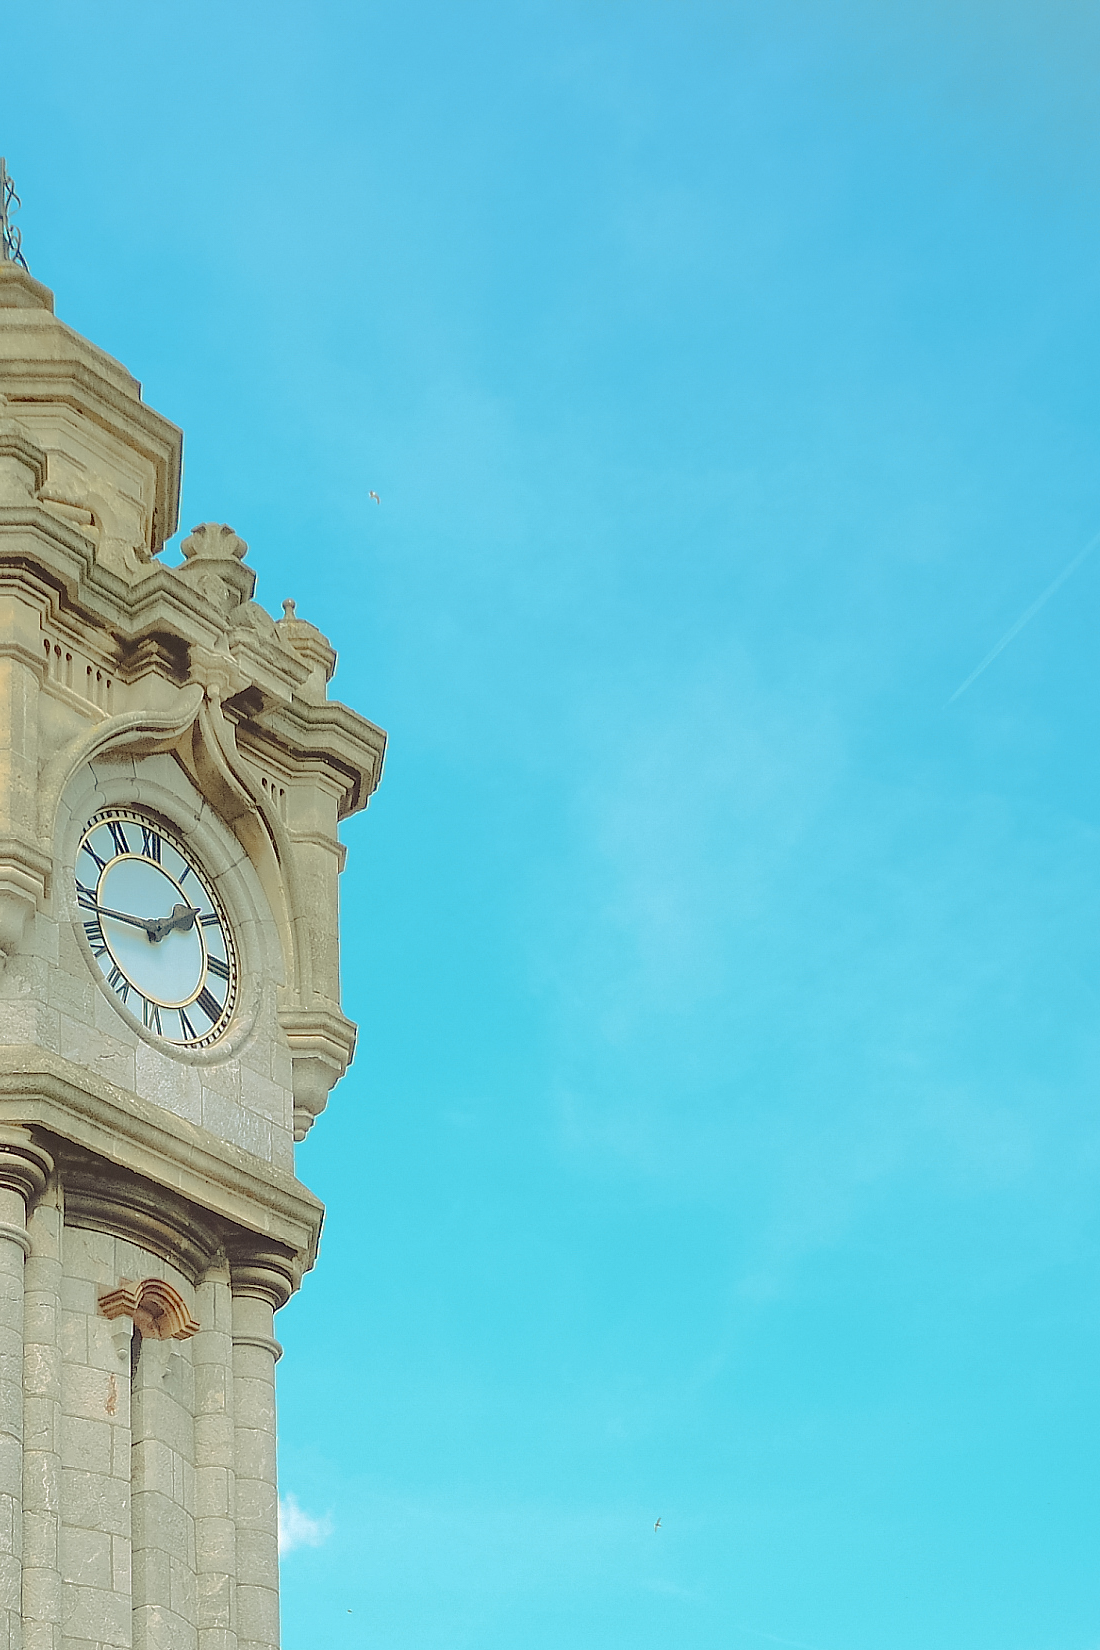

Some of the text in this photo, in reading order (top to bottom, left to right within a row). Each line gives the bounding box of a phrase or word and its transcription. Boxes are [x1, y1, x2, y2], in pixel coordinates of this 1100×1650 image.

[82, 838, 106, 871] X
[106, 821, 130, 856] XI
[141, 827, 161, 865] XII
[84, 920, 106, 957] VIII
[207, 953, 230, 980] III
[106, 965, 129, 1005] VII
[143, 997, 162, 1037] VI
[179, 1007, 199, 1040] V
